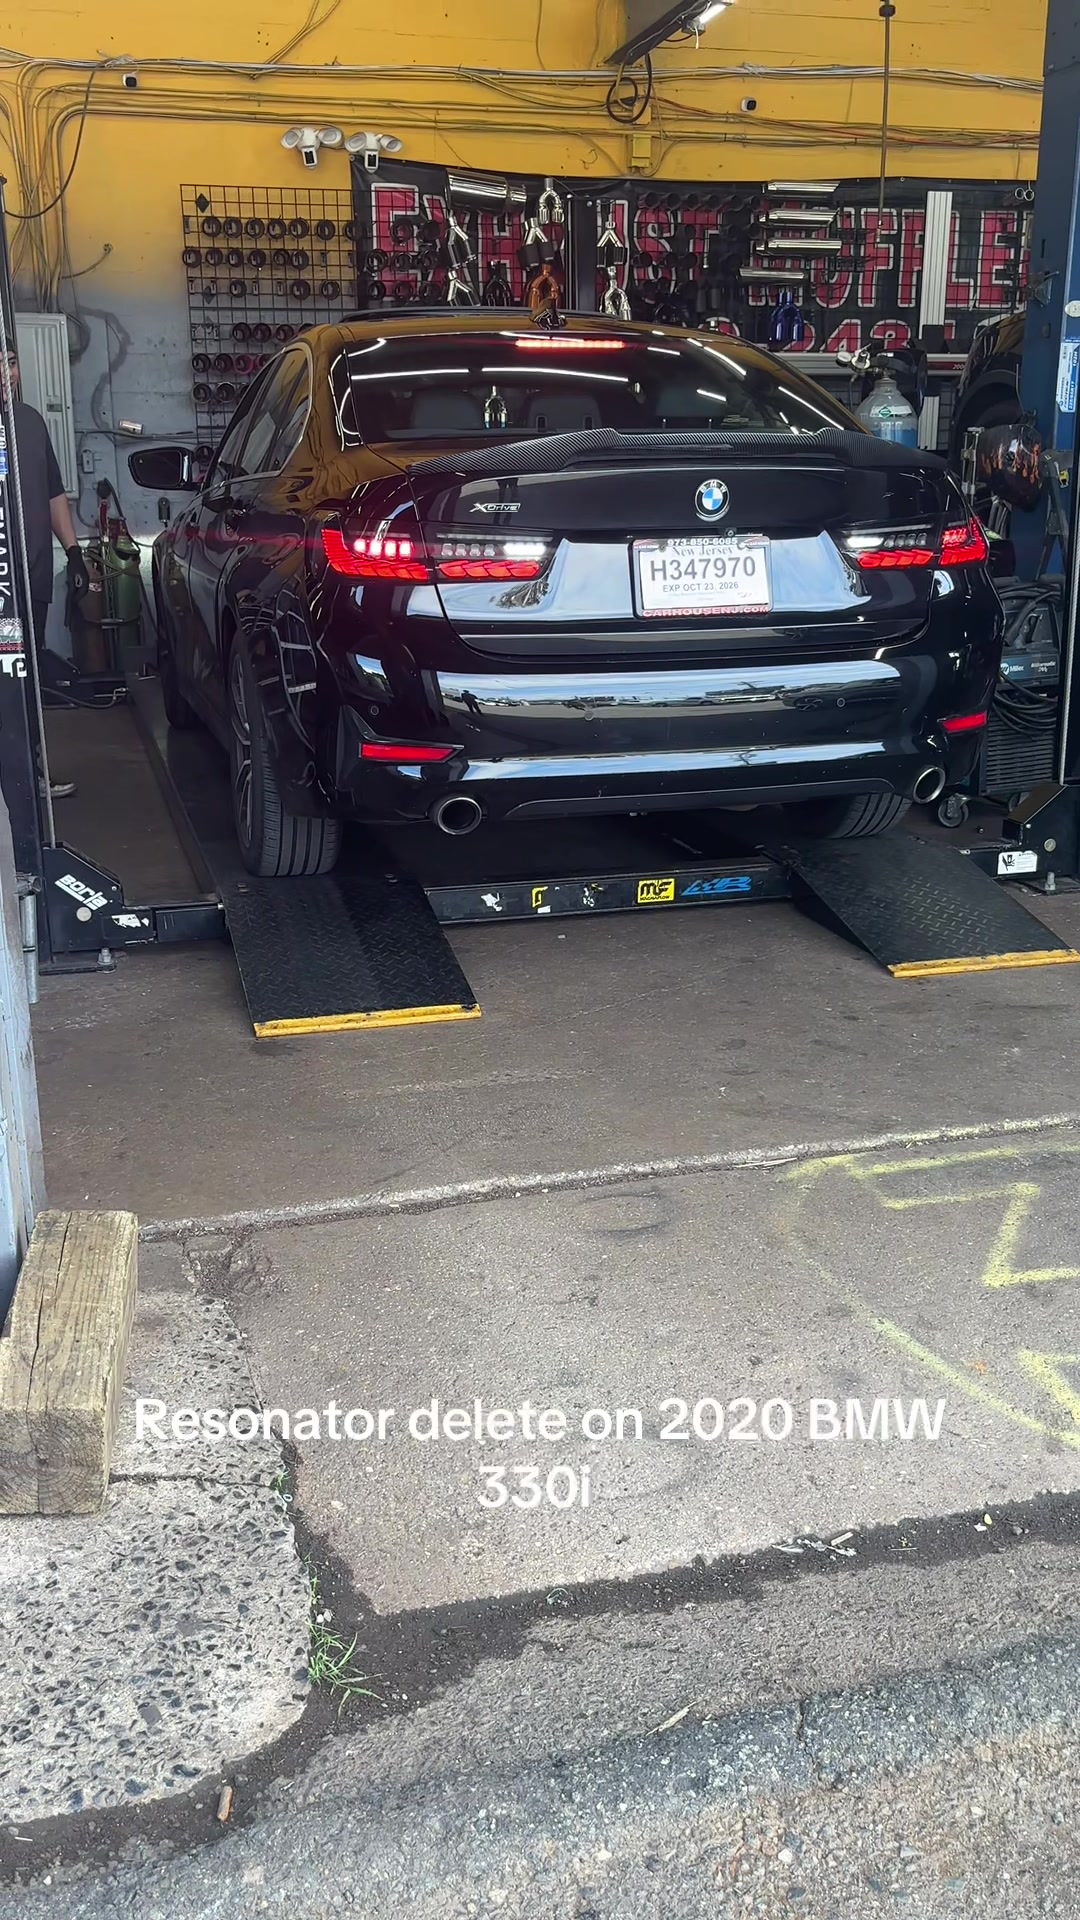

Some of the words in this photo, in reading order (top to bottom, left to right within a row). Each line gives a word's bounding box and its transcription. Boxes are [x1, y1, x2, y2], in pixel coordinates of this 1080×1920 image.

[700, 480, 727, 493] BMW
[667, 537, 738, 547] 973-850-6085
[672, 547, 696, 557] New
[698, 546, 734, 557] Jersey
[650, 556, 756, 581] H347970
[662, 584, 681, 593] EXP
[683, 583, 701, 592] OCT
[719, 581, 739, 590] 2026
[642, 606, 769, 617] CARHOUSENJ.COM
